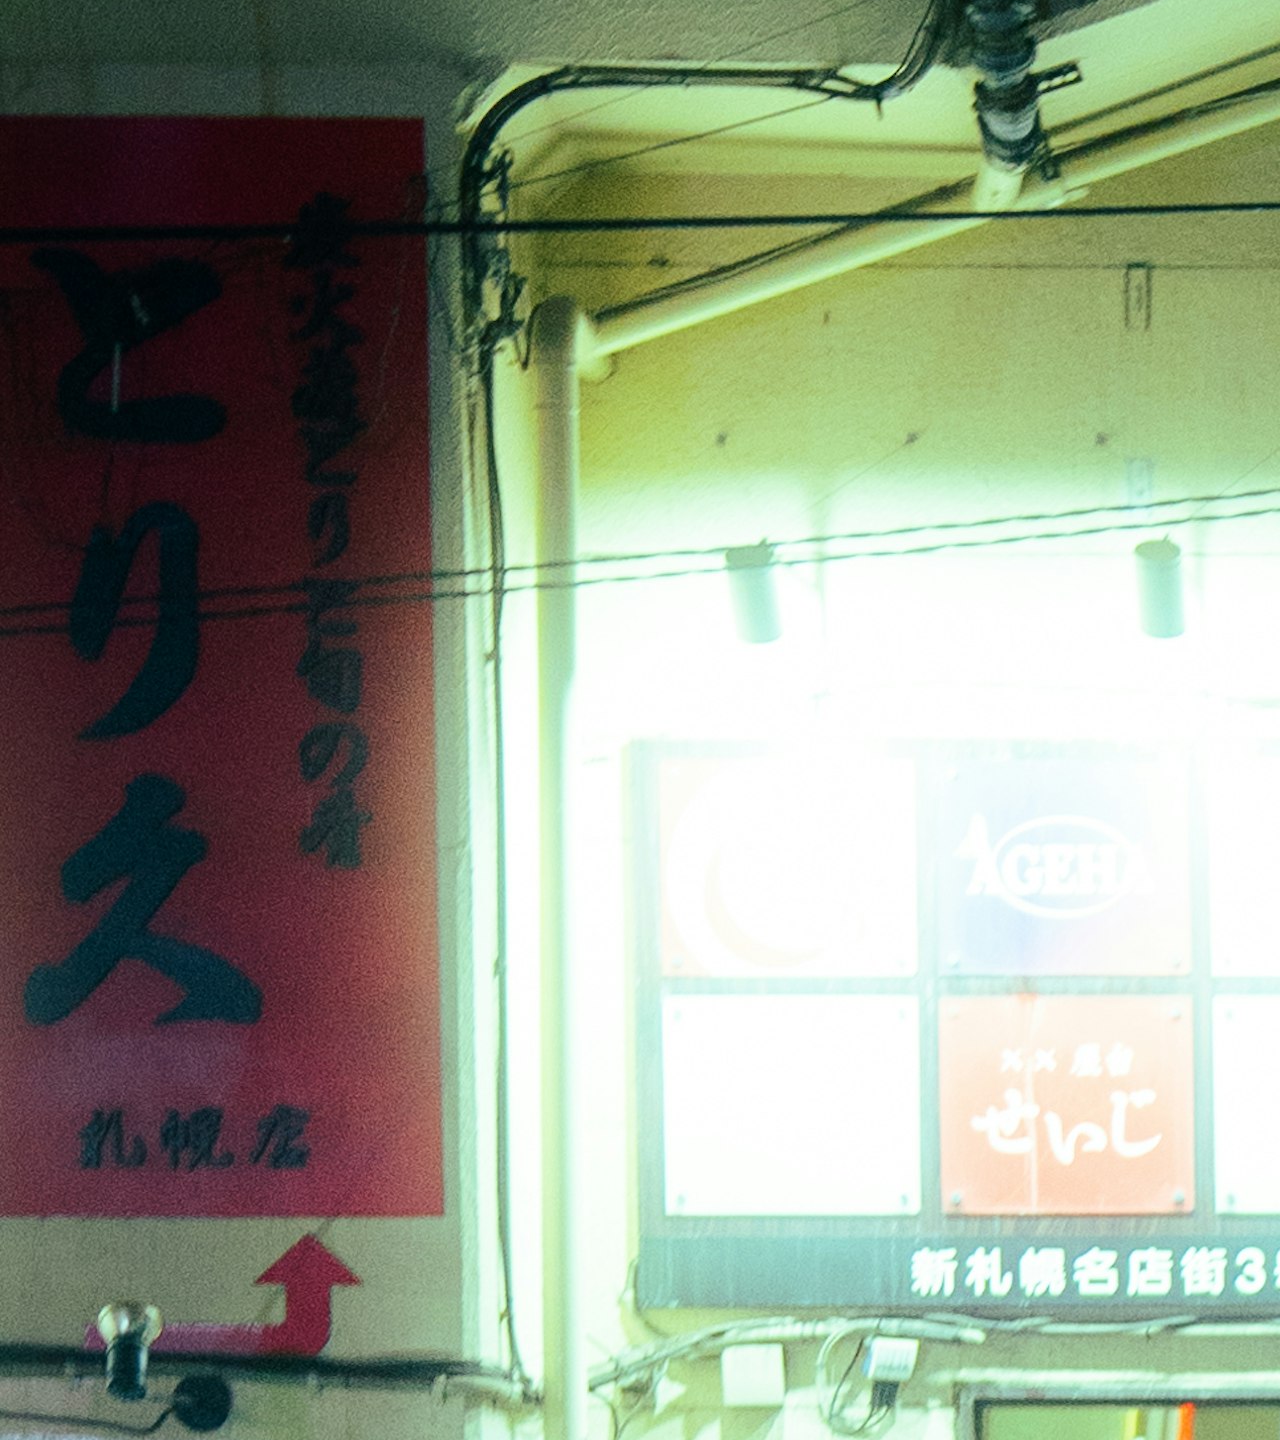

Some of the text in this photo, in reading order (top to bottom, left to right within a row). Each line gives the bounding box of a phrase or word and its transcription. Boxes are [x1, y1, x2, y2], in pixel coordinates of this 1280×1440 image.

[22, 248, 262, 1026] とり久
[78, 1103, 311, 1169] 札幌店
[970, 1087, 1163, 1166] せいじ
